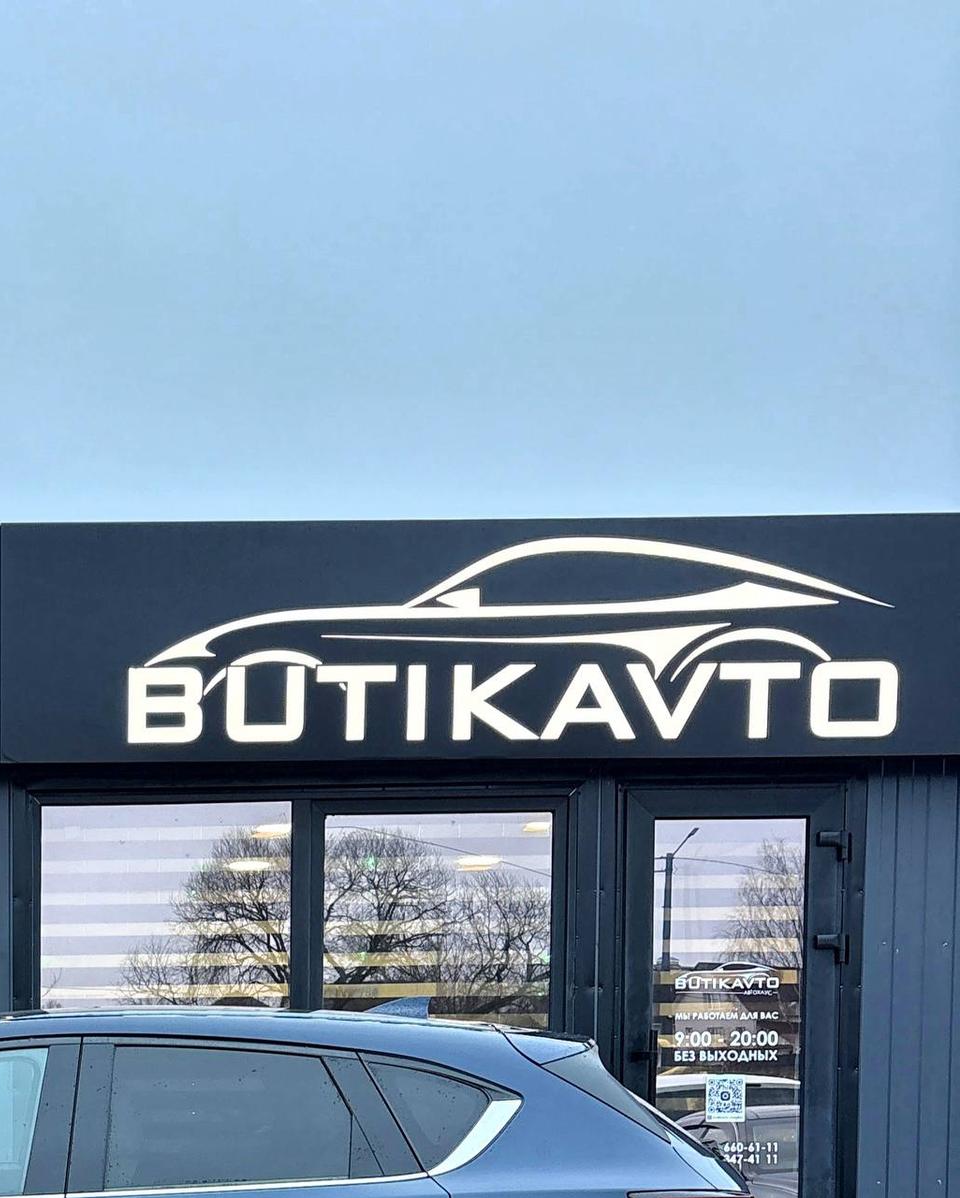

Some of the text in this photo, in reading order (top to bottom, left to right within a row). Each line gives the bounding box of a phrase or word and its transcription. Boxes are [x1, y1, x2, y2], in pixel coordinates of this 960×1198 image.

[126, 659, 900, 745] BUTIKAVTO
[674, 976, 780, 990] BUTIKAVTO
[675, 1011, 779, 1021] МЫ РАБОТАЕМ ДЛЯ ВАС
[674, 1031, 712, 1047] 9:00
[730, 1030, 779, 1047] 20:00
[674, 1050, 778, 1063] БЕЗ ВЫХОДНЫХ
[723, 1142, 778, 1152] 660-61-11
